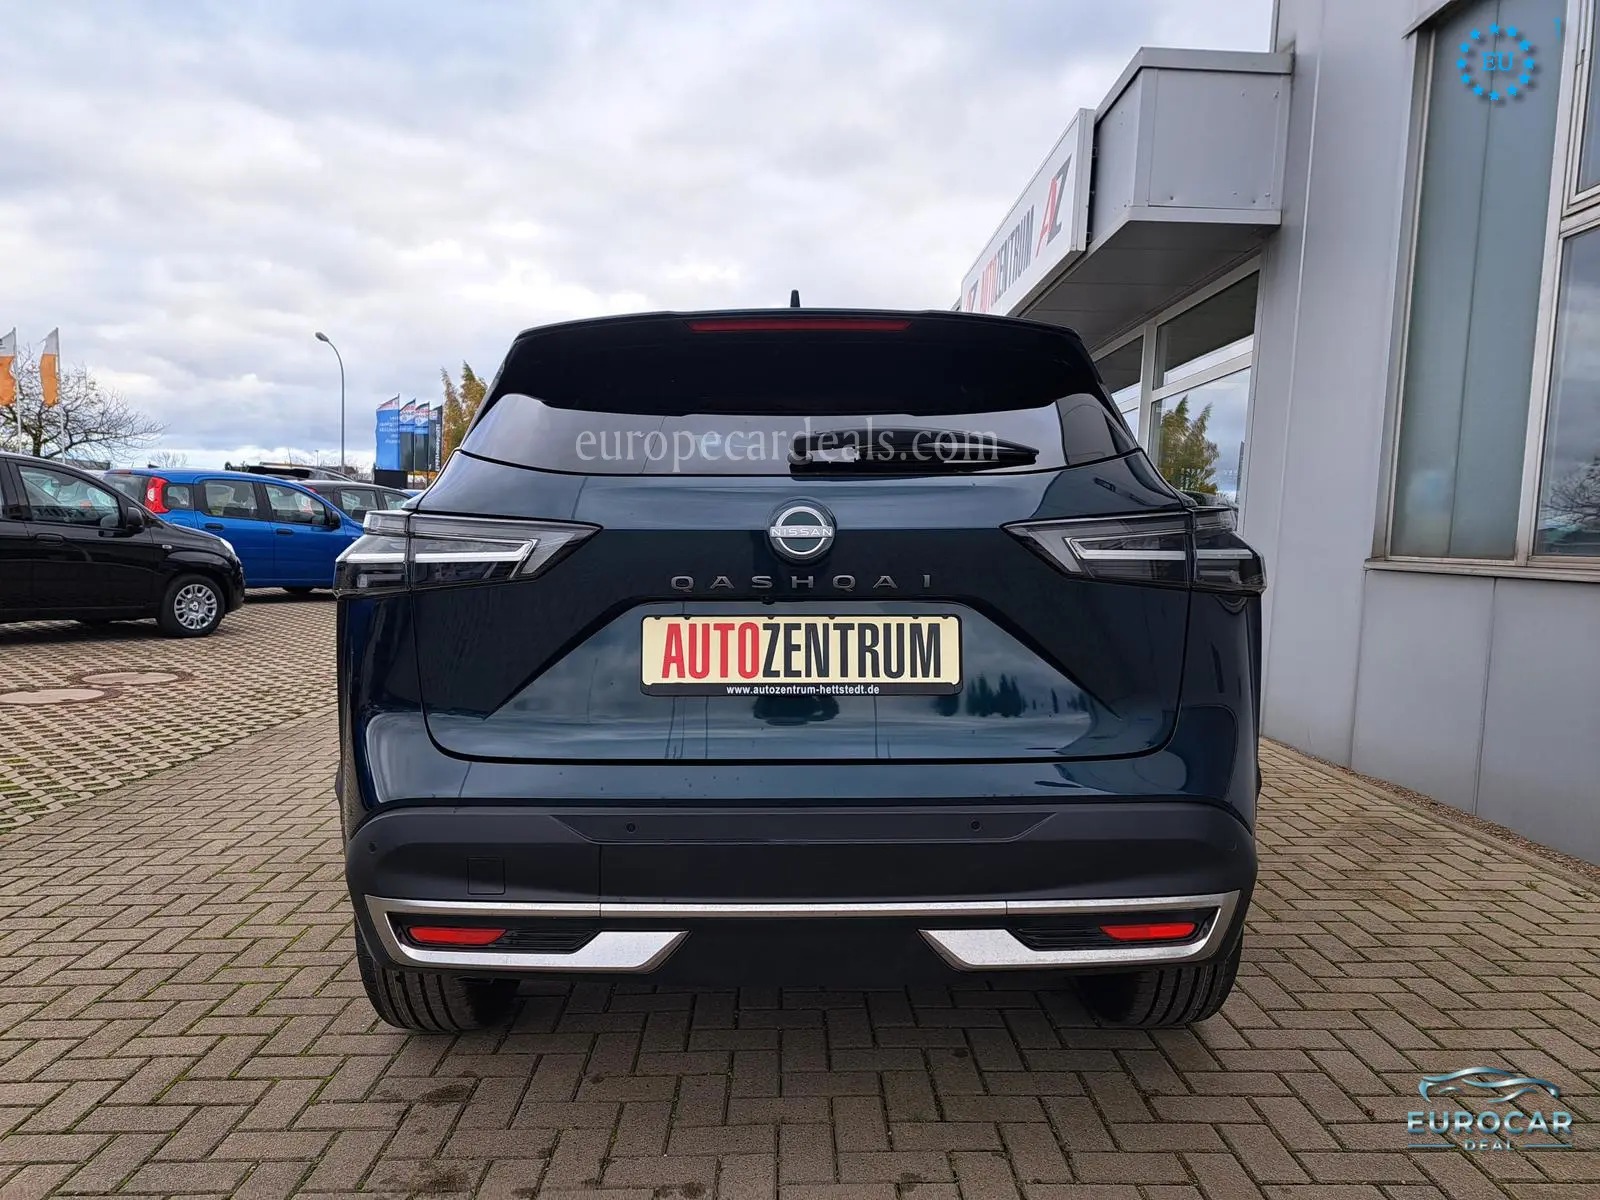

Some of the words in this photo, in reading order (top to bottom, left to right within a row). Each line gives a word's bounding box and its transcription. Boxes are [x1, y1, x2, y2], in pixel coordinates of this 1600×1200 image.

[771, 527, 833, 538] NISSAN
[670, 574, 931, 591] QASHQAI
[661, 621, 942, 680] AUTOZENTRUM
[726, 684, 880, 695] www.autozentrum-hettstedt.de
